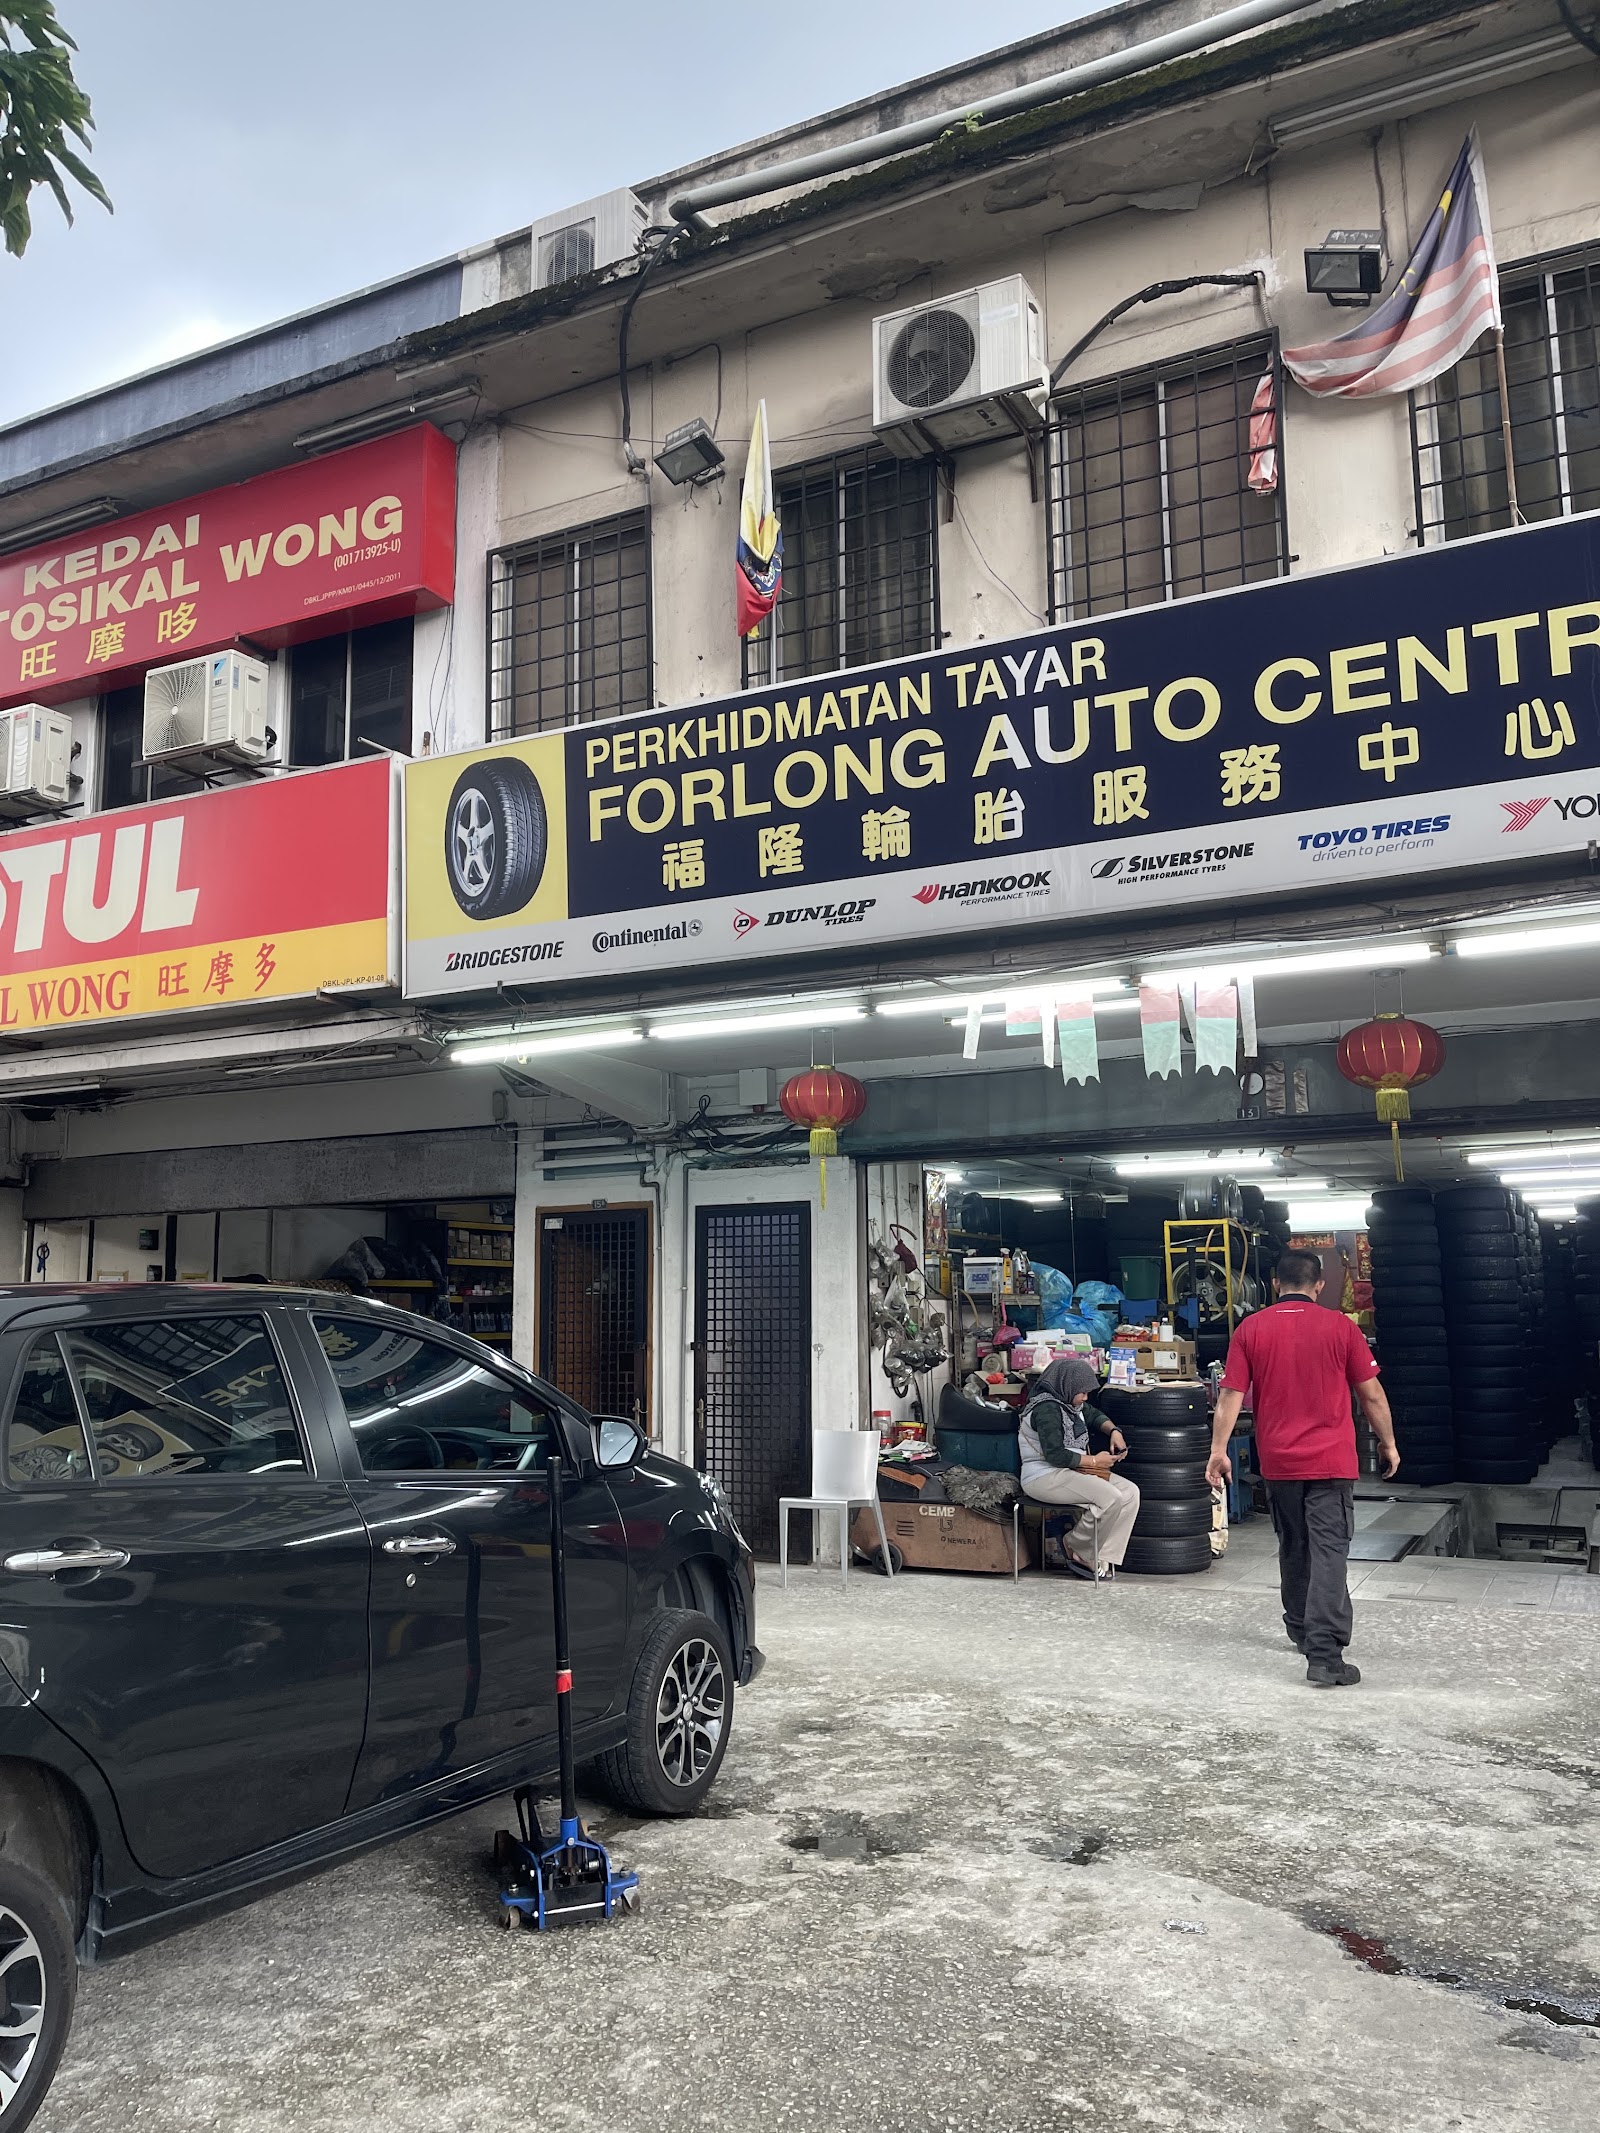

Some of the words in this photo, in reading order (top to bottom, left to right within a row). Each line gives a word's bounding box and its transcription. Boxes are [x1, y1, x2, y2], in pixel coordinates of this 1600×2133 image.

[23, 514, 200, 597] KEDAI
[219, 495, 402, 583] WONG
[333, 538, 401, 571] (001713925-U)
[586, 668, 932, 778] PERKHIDMATAN
[946, 637, 1107, 709] TAYAR
[588, 728, 946, 842] FORLONG
[972, 676, 1221, 778] AUTO
[662, 697, 1576, 892] 福隆輪胎服務中心
[1553, 794, 1600, 821] YO
[1297, 826, 1368, 851] TOYO
[1371, 815, 1451, 841] TIRES
[1312, 846, 1356, 862] driven
[1359, 844, 1373, 856] to
[1375, 837, 1434, 857] perform
[1118, 875, 1138, 885] HIGH
[1140, 867, 1199, 882] PERFORMANCE
[1202, 863, 1226, 874] TYRES
[1127, 842, 1254, 873] SILVERSTONE
[0, 815, 200, 954] TUL
[960, 891, 1023, 906] PERFORMANCE
[1026, 887, 1051, 899] TIRES
[764, 898, 876, 926] DUNLOP
[824, 914, 864, 926] TIRES
[592, 921, 688, 953] Continental
[157, 942, 276, 998] 旺摩多
[445, 941, 564, 972] BRIDGESTONE
[27, 969, 131, 1021] WONG
